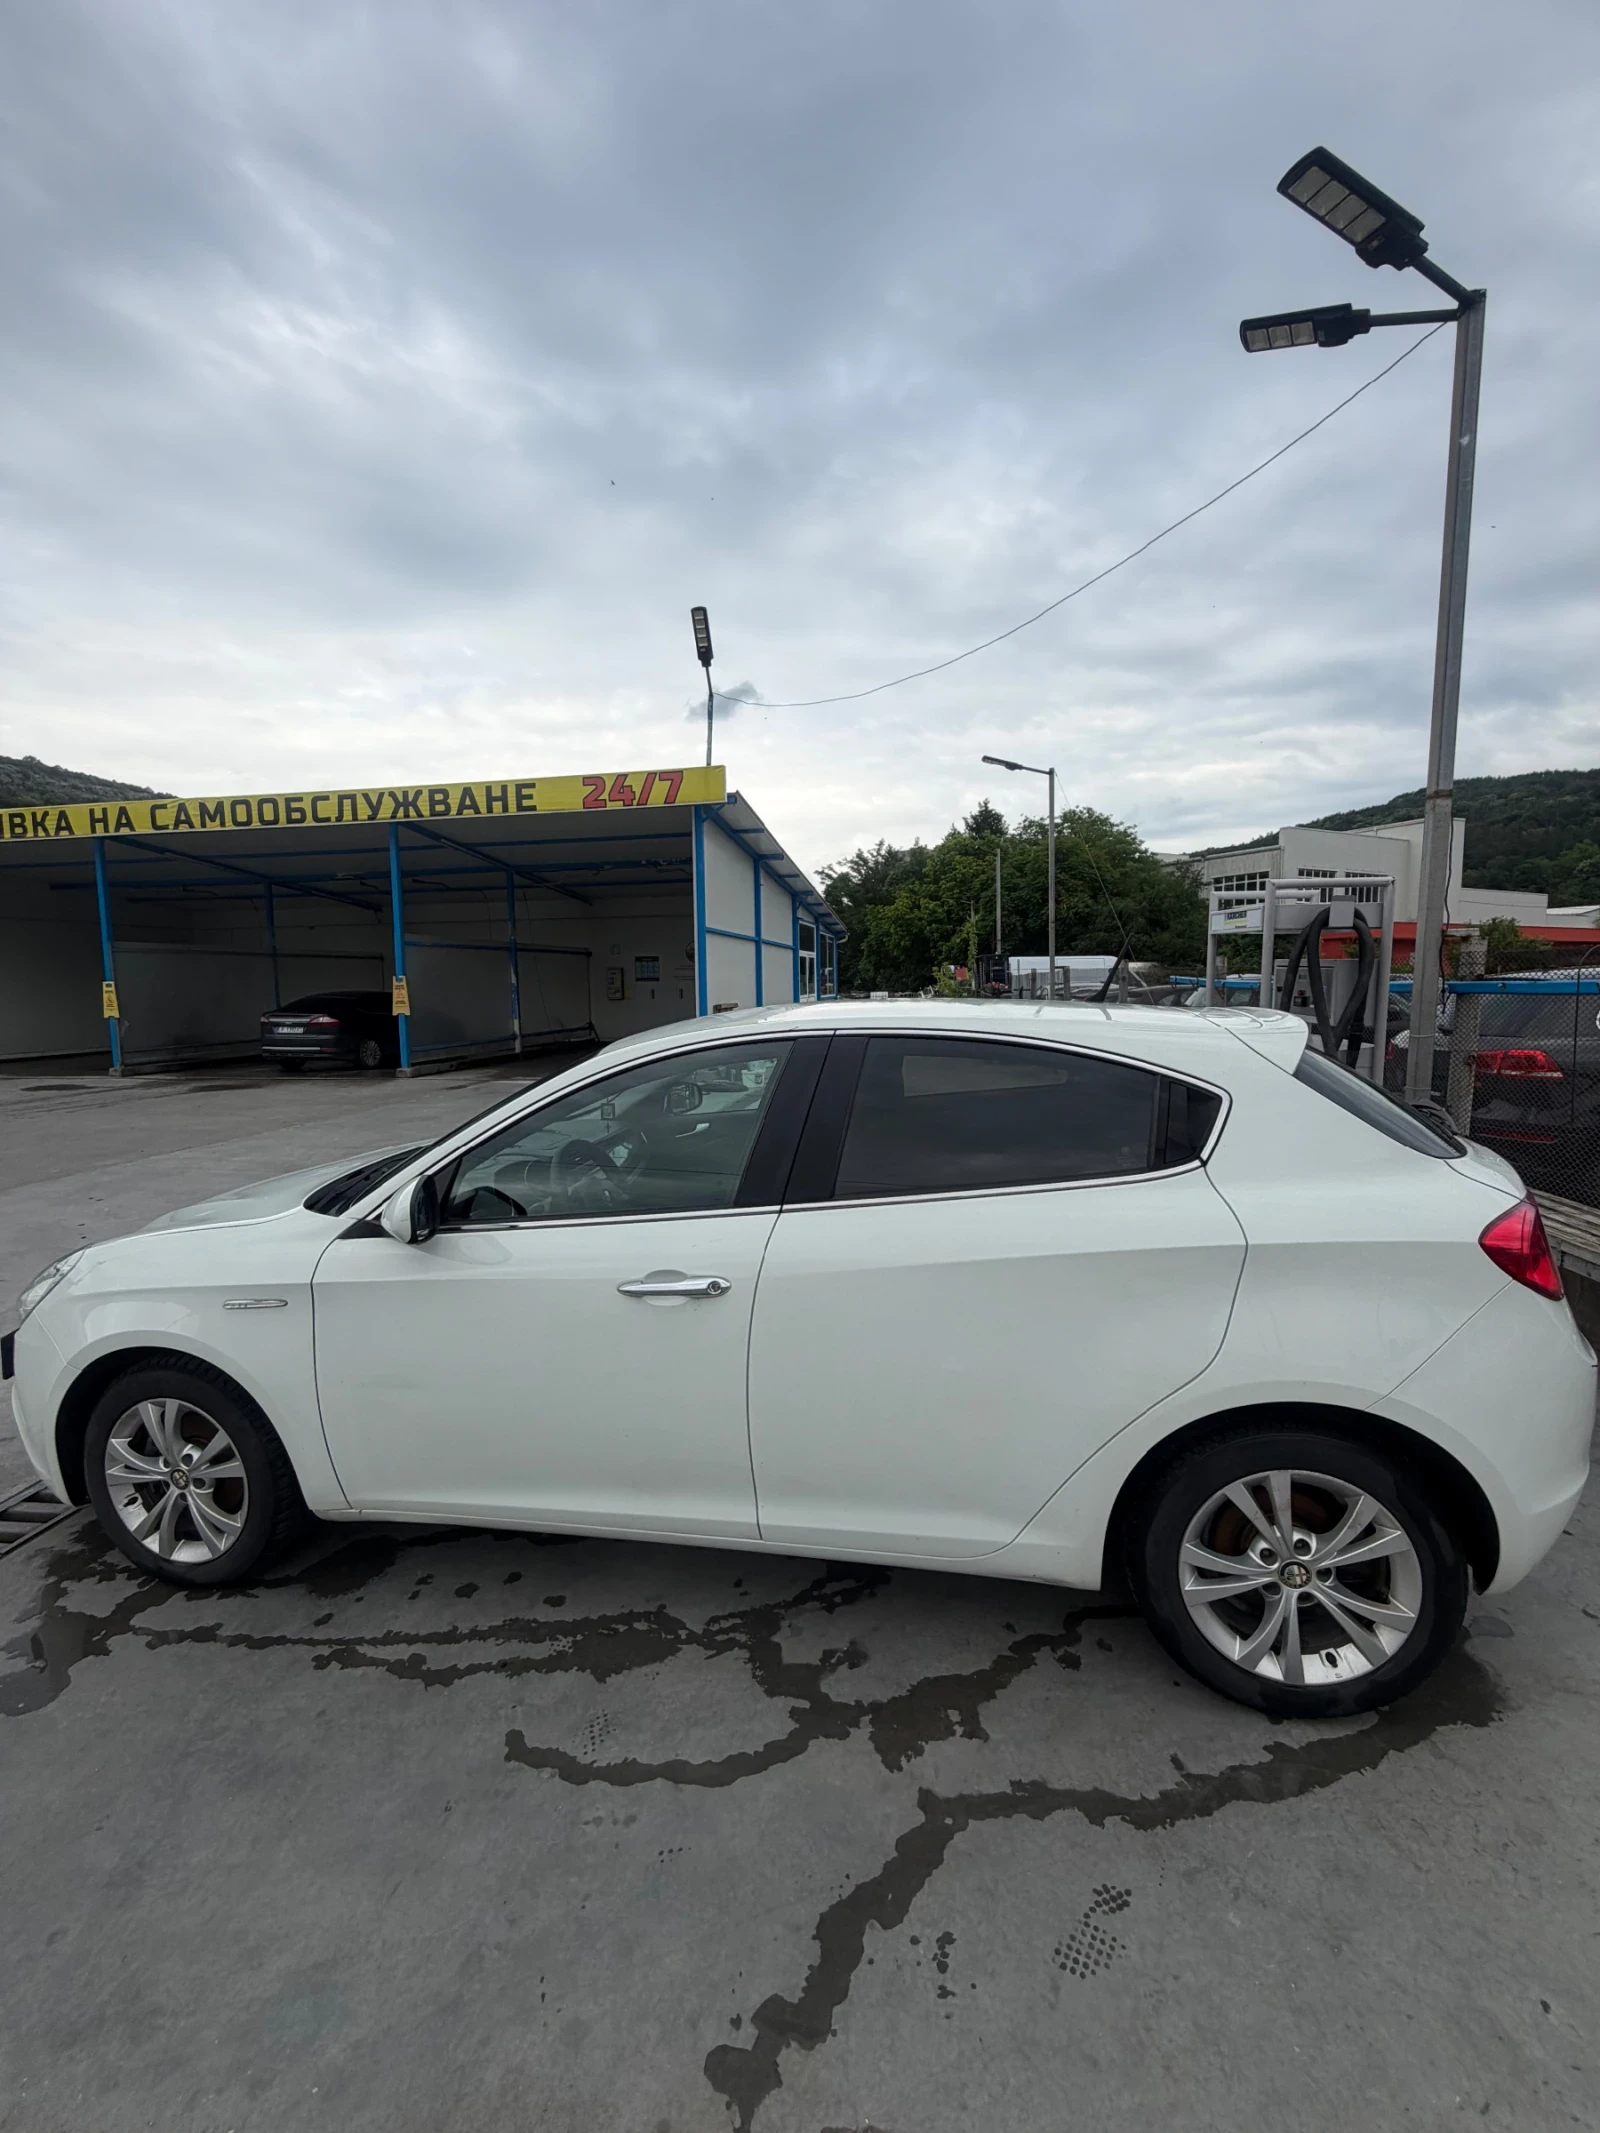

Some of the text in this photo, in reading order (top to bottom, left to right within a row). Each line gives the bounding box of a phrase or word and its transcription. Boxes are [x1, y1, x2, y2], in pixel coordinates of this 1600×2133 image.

[0, 770, 684, 839] ВКА НА САМООБСЛУЖВАНЕ 24/7
